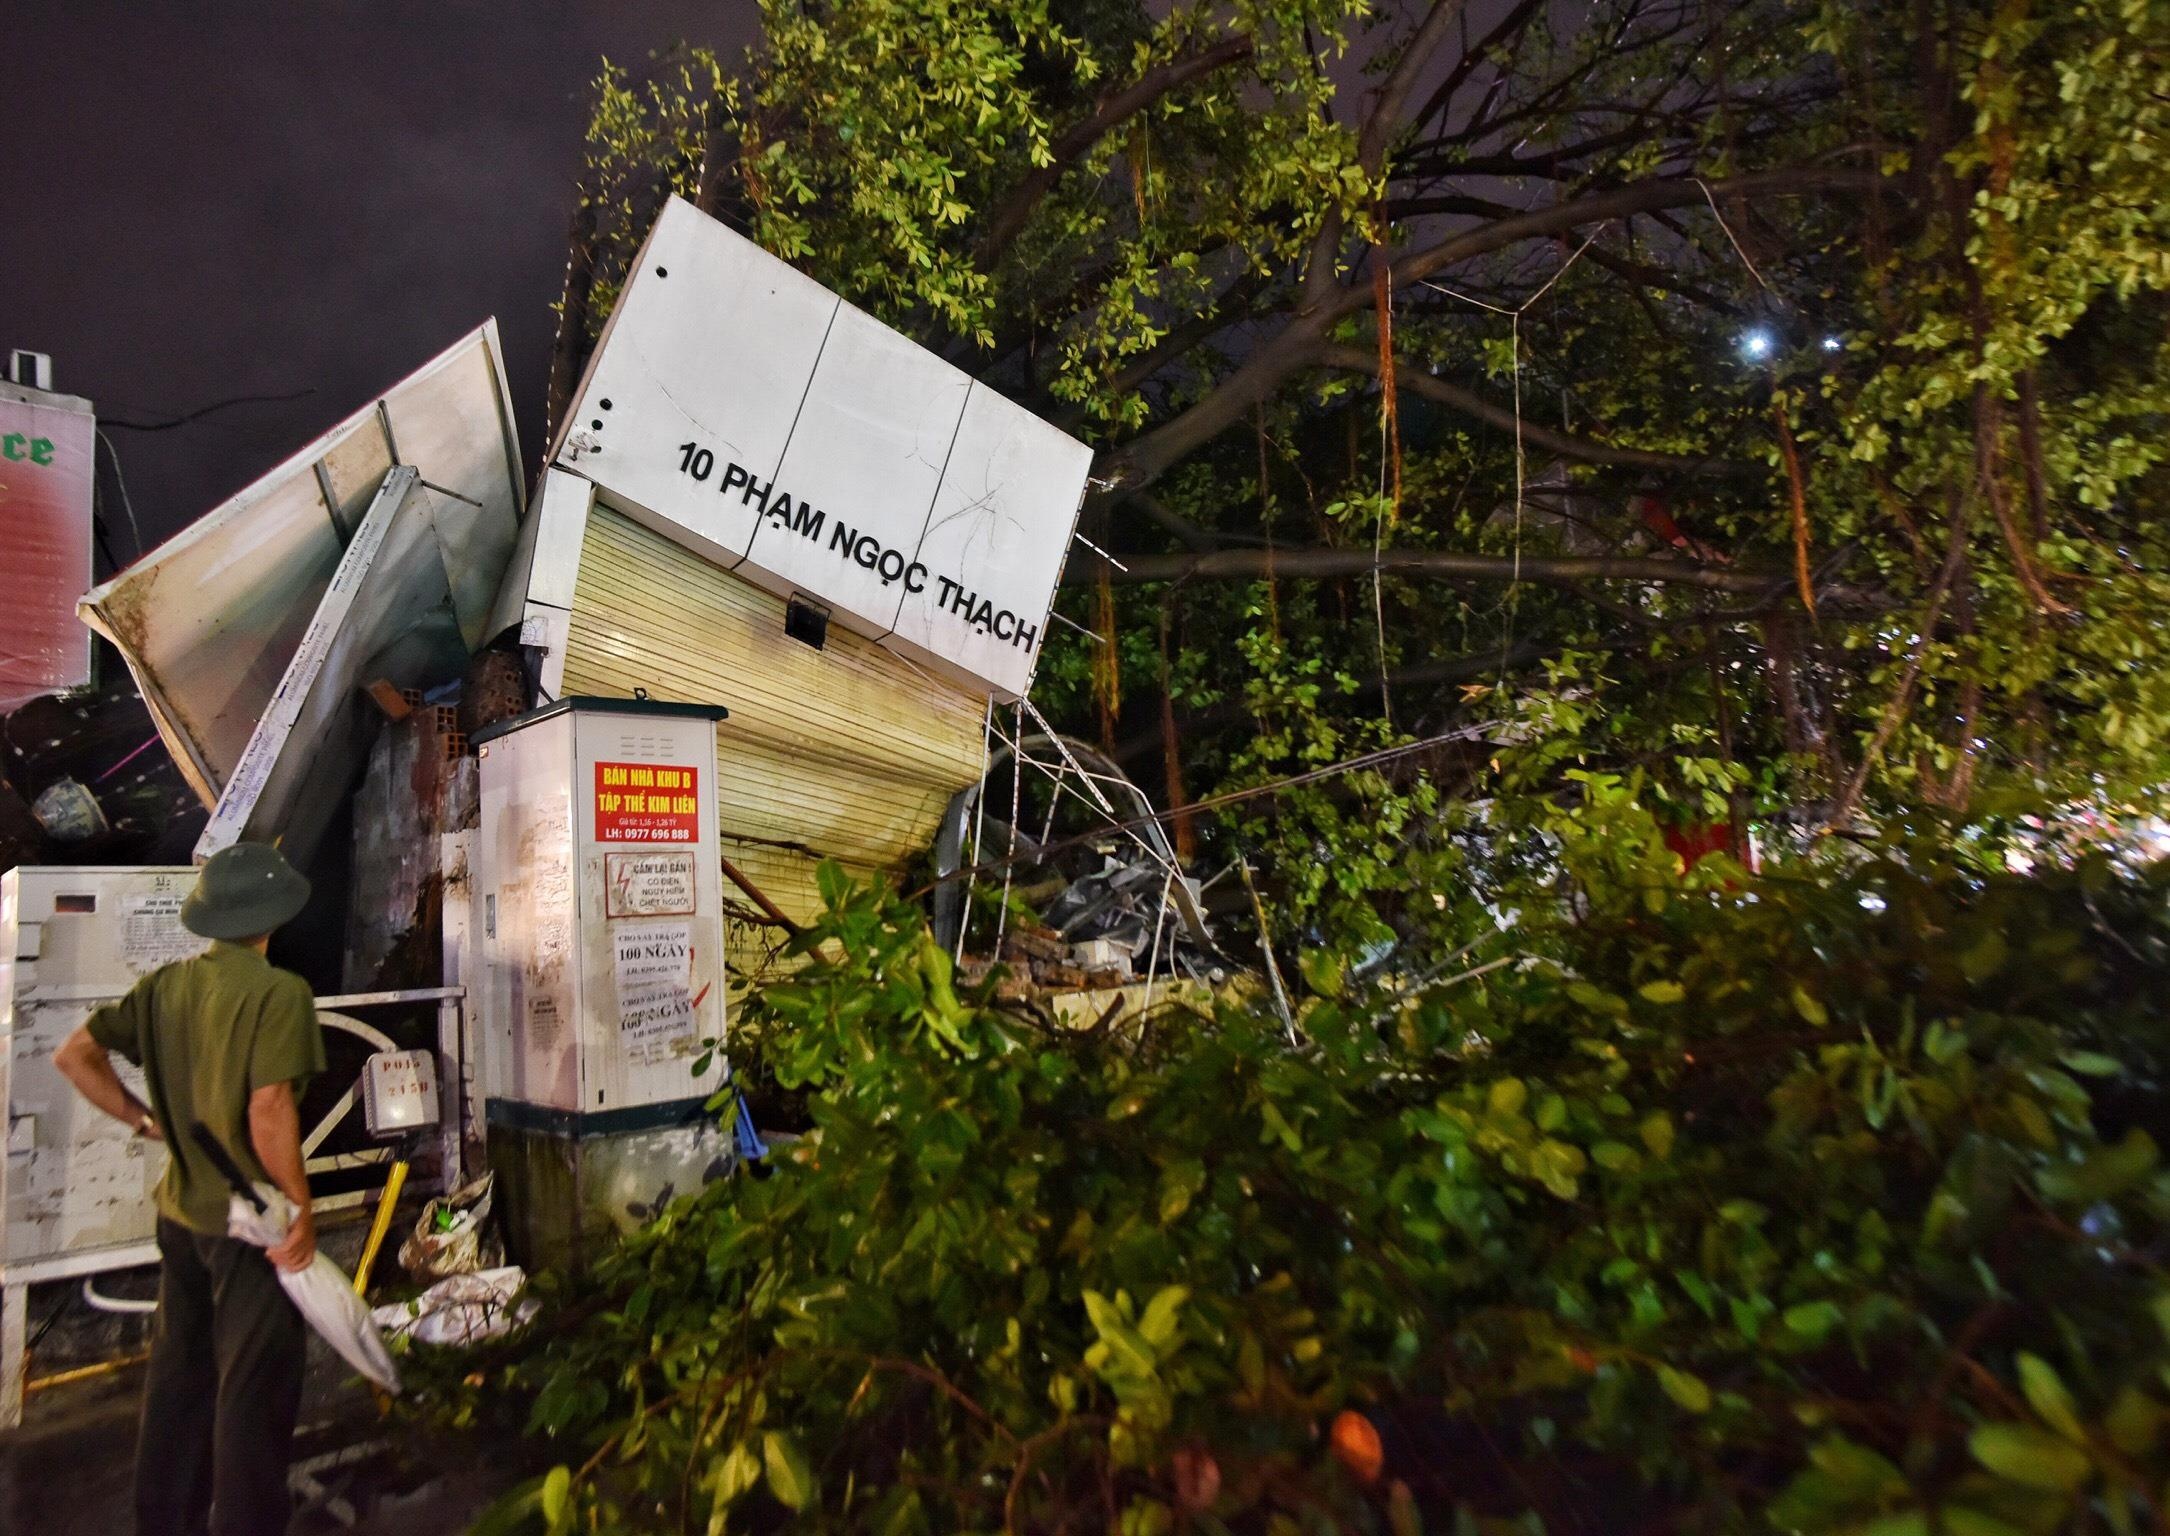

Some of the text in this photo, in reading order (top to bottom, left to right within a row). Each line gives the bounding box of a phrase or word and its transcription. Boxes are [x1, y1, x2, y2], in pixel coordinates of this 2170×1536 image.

[679, 442, 1038, 654] 10 PHẠM NGỌC THẠCH
[604, 766, 691, 788] BÁN NHÀ KHU B
[599, 790, 695, 814] TẬP THỂ KIM LIÊN
[605, 828, 689, 839] LH: 0977 696 888
[620, 947, 640, 960] 100
